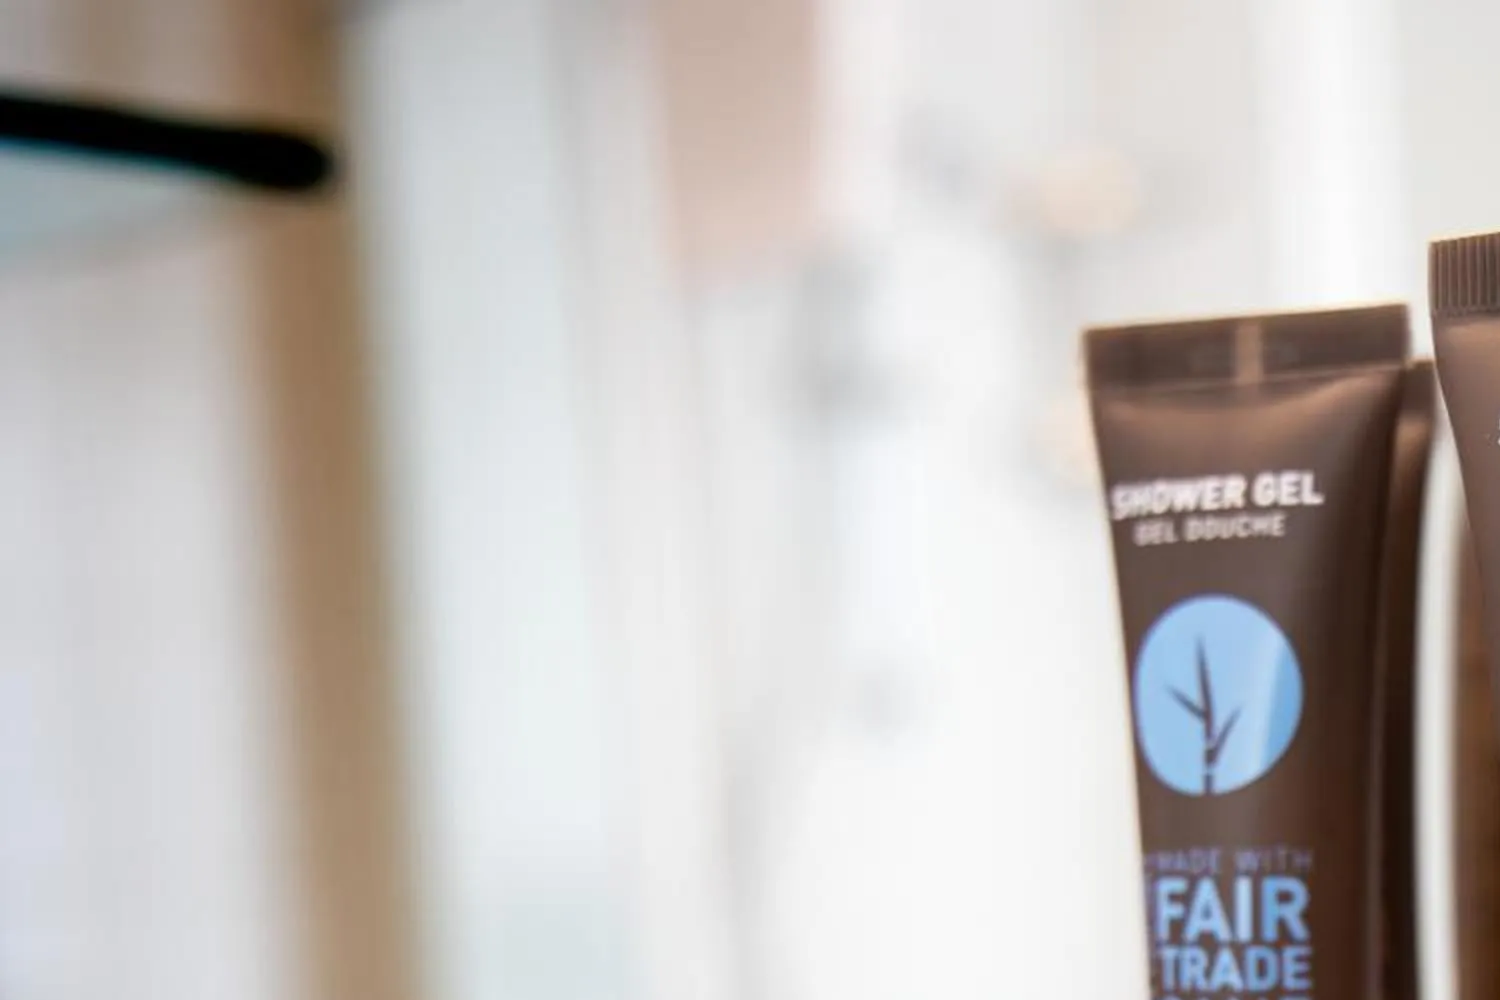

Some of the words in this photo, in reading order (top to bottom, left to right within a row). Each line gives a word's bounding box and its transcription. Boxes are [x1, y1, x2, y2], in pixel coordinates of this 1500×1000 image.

[1112, 476, 1247, 520] SHOWER
[1253, 471, 1324, 506] GEL
[1135, 519, 1179, 546] GEL
[1184, 514, 1286, 543] DOUCHE
[1156, 875, 1310, 942] FAIR
[1160, 945, 1312, 992] TRADE
